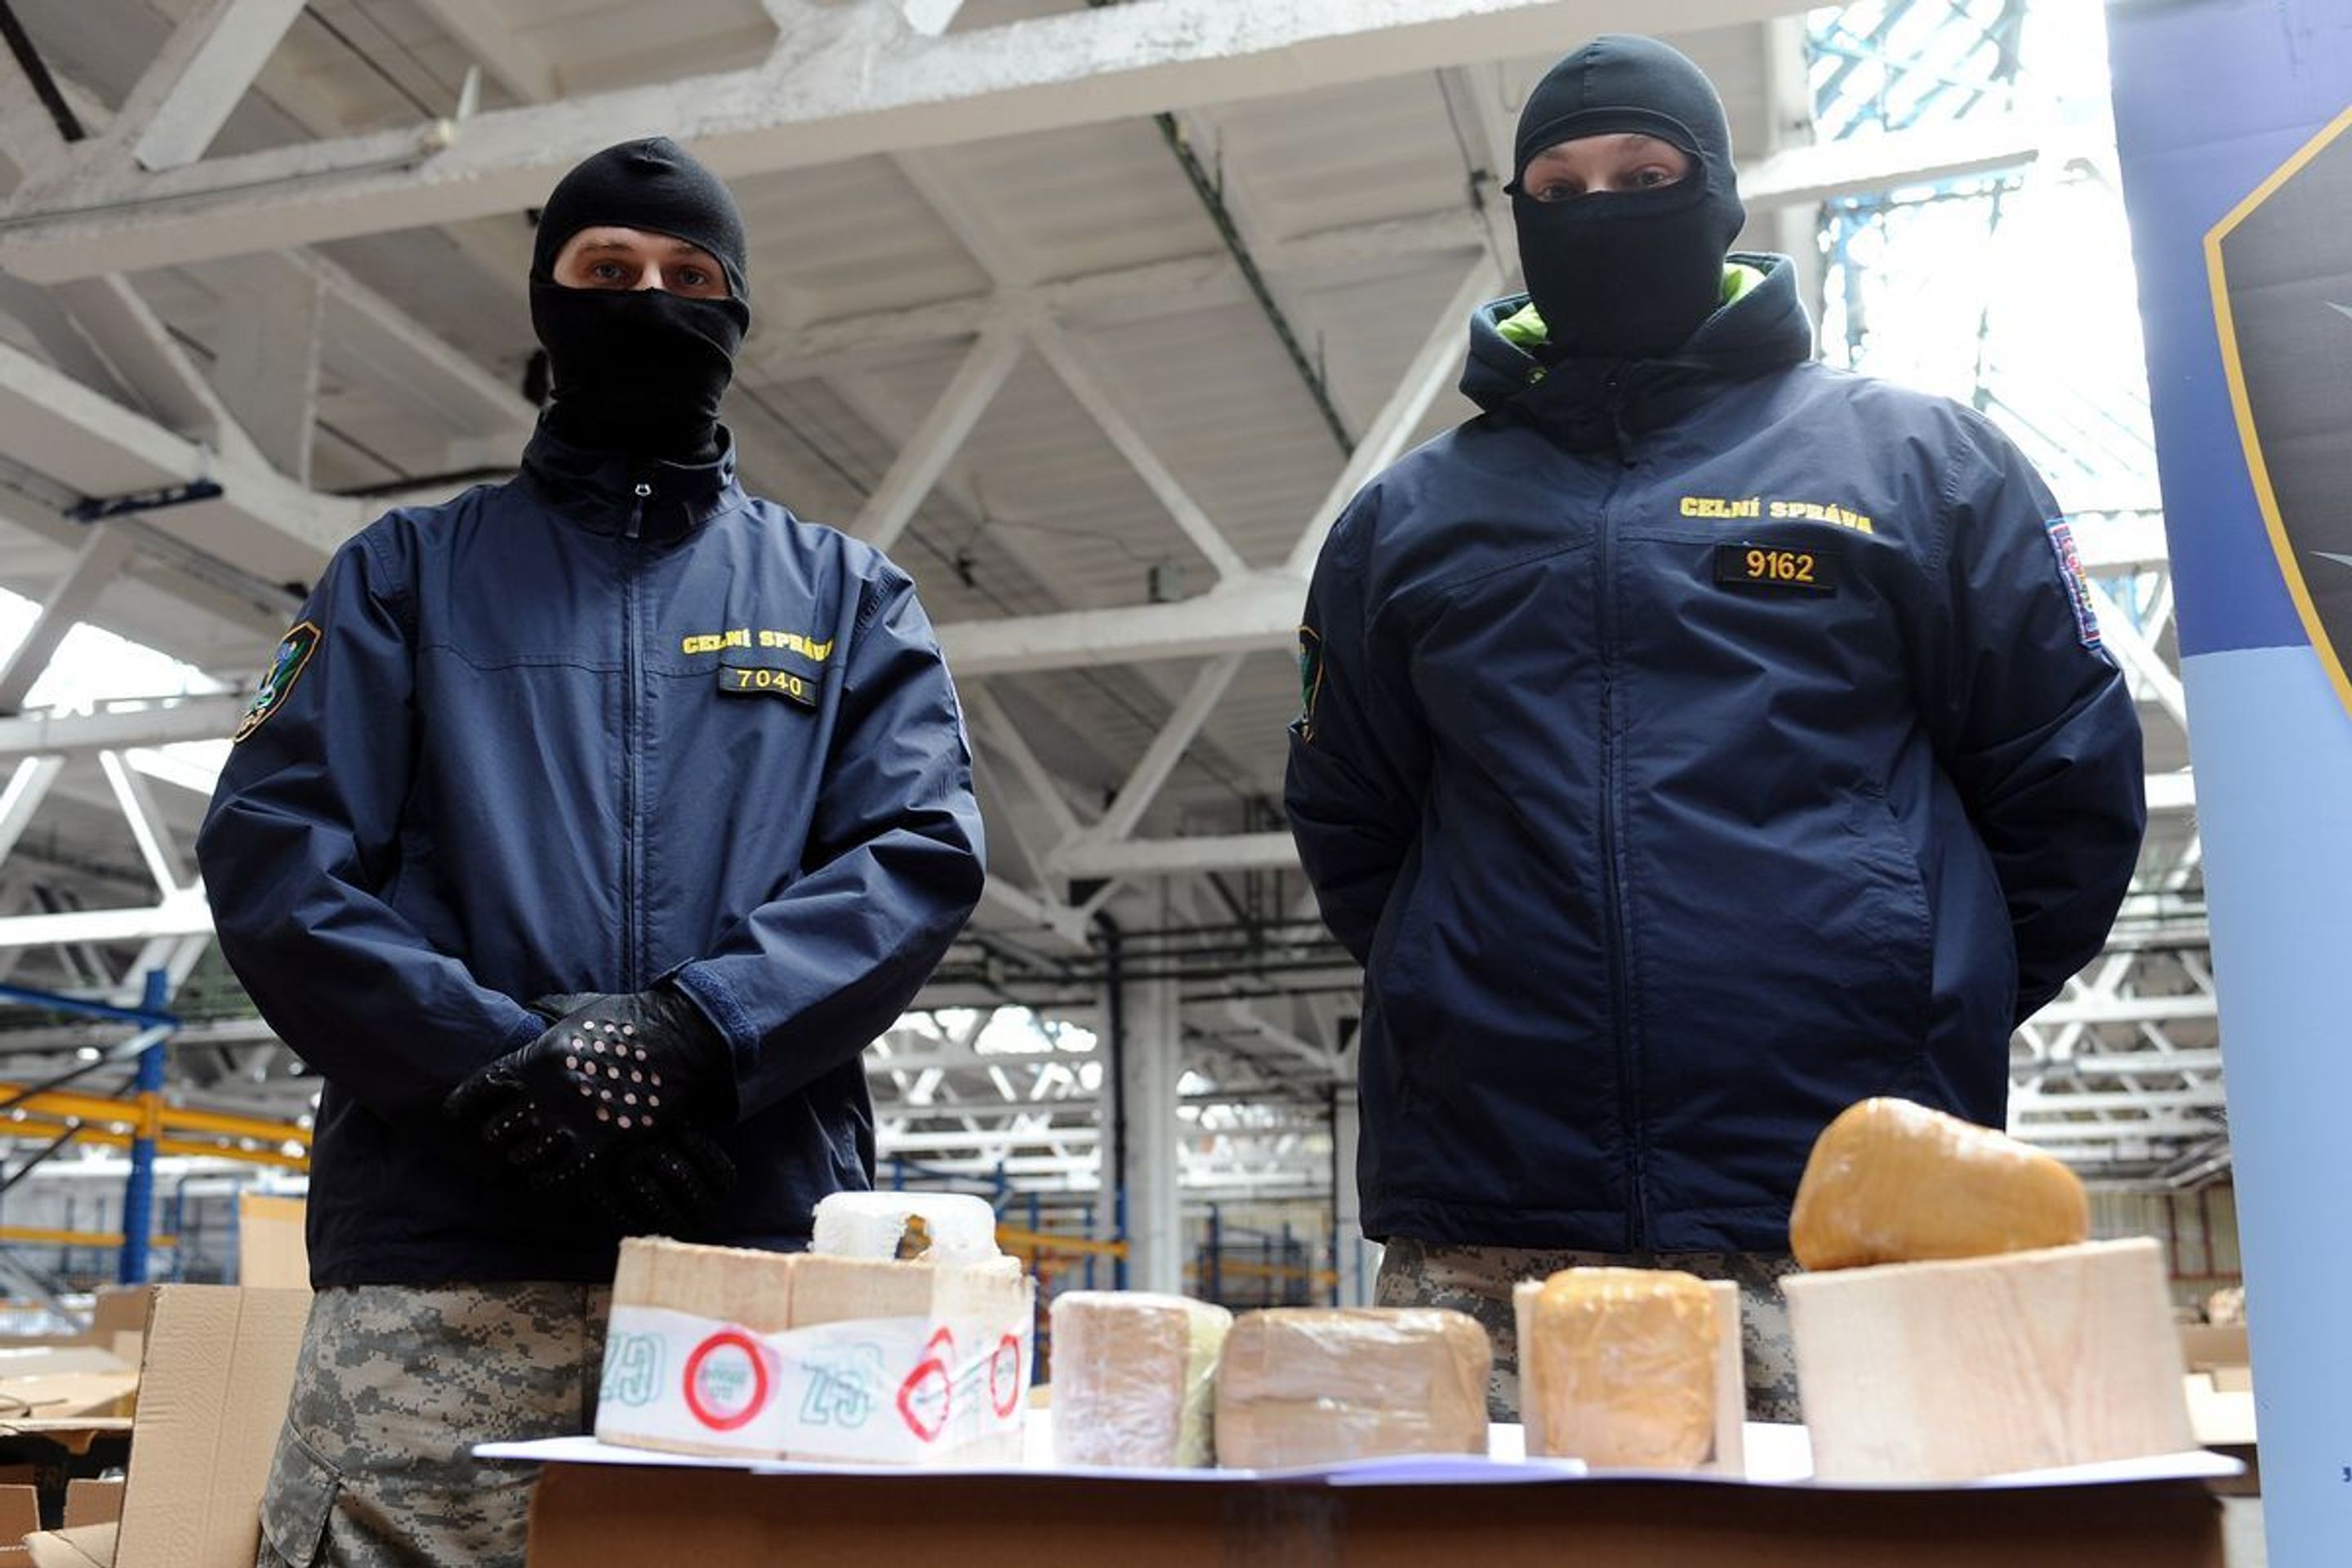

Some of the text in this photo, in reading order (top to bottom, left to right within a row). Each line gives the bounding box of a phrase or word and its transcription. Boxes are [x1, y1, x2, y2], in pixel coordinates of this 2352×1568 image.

[1680, 497, 1873, 534] CELNÍ SPRÁVA
[1745, 550, 1814, 581] 9162
[683, 627, 751, 654] CELNÍ
[737, 670, 802, 695] 7040
